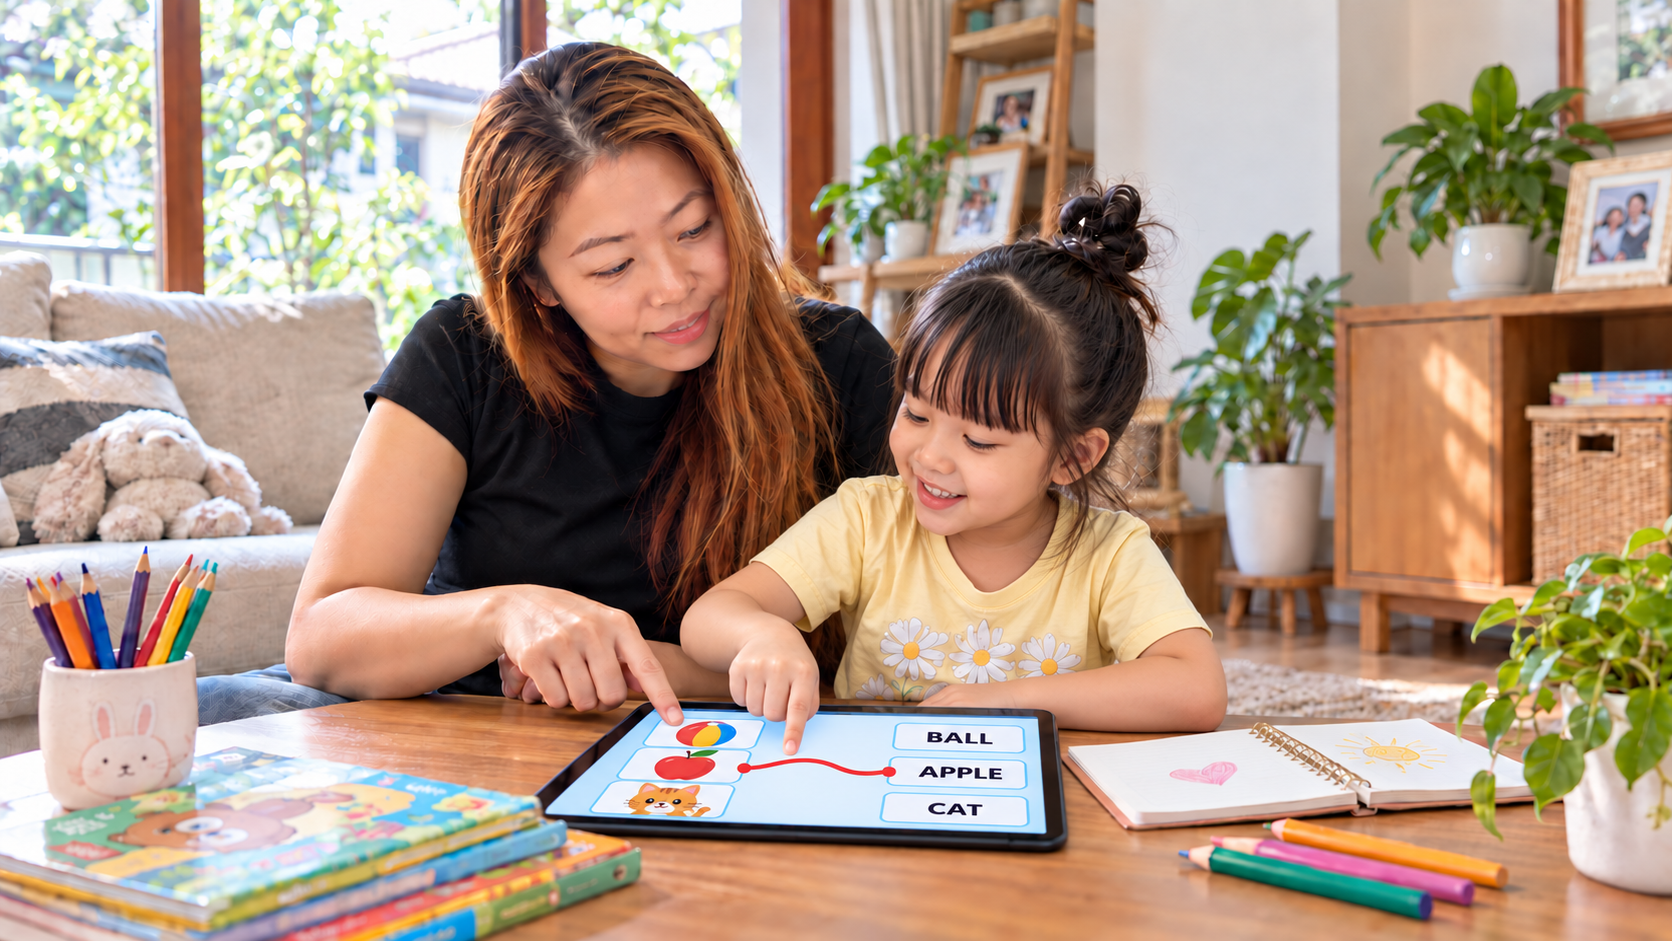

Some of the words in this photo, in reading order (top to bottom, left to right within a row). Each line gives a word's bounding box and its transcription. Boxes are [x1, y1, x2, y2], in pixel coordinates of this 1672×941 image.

[926, 731, 993, 745] BALL
[918, 765, 1003, 780] APPLE
[927, 802, 983, 816] CAT
